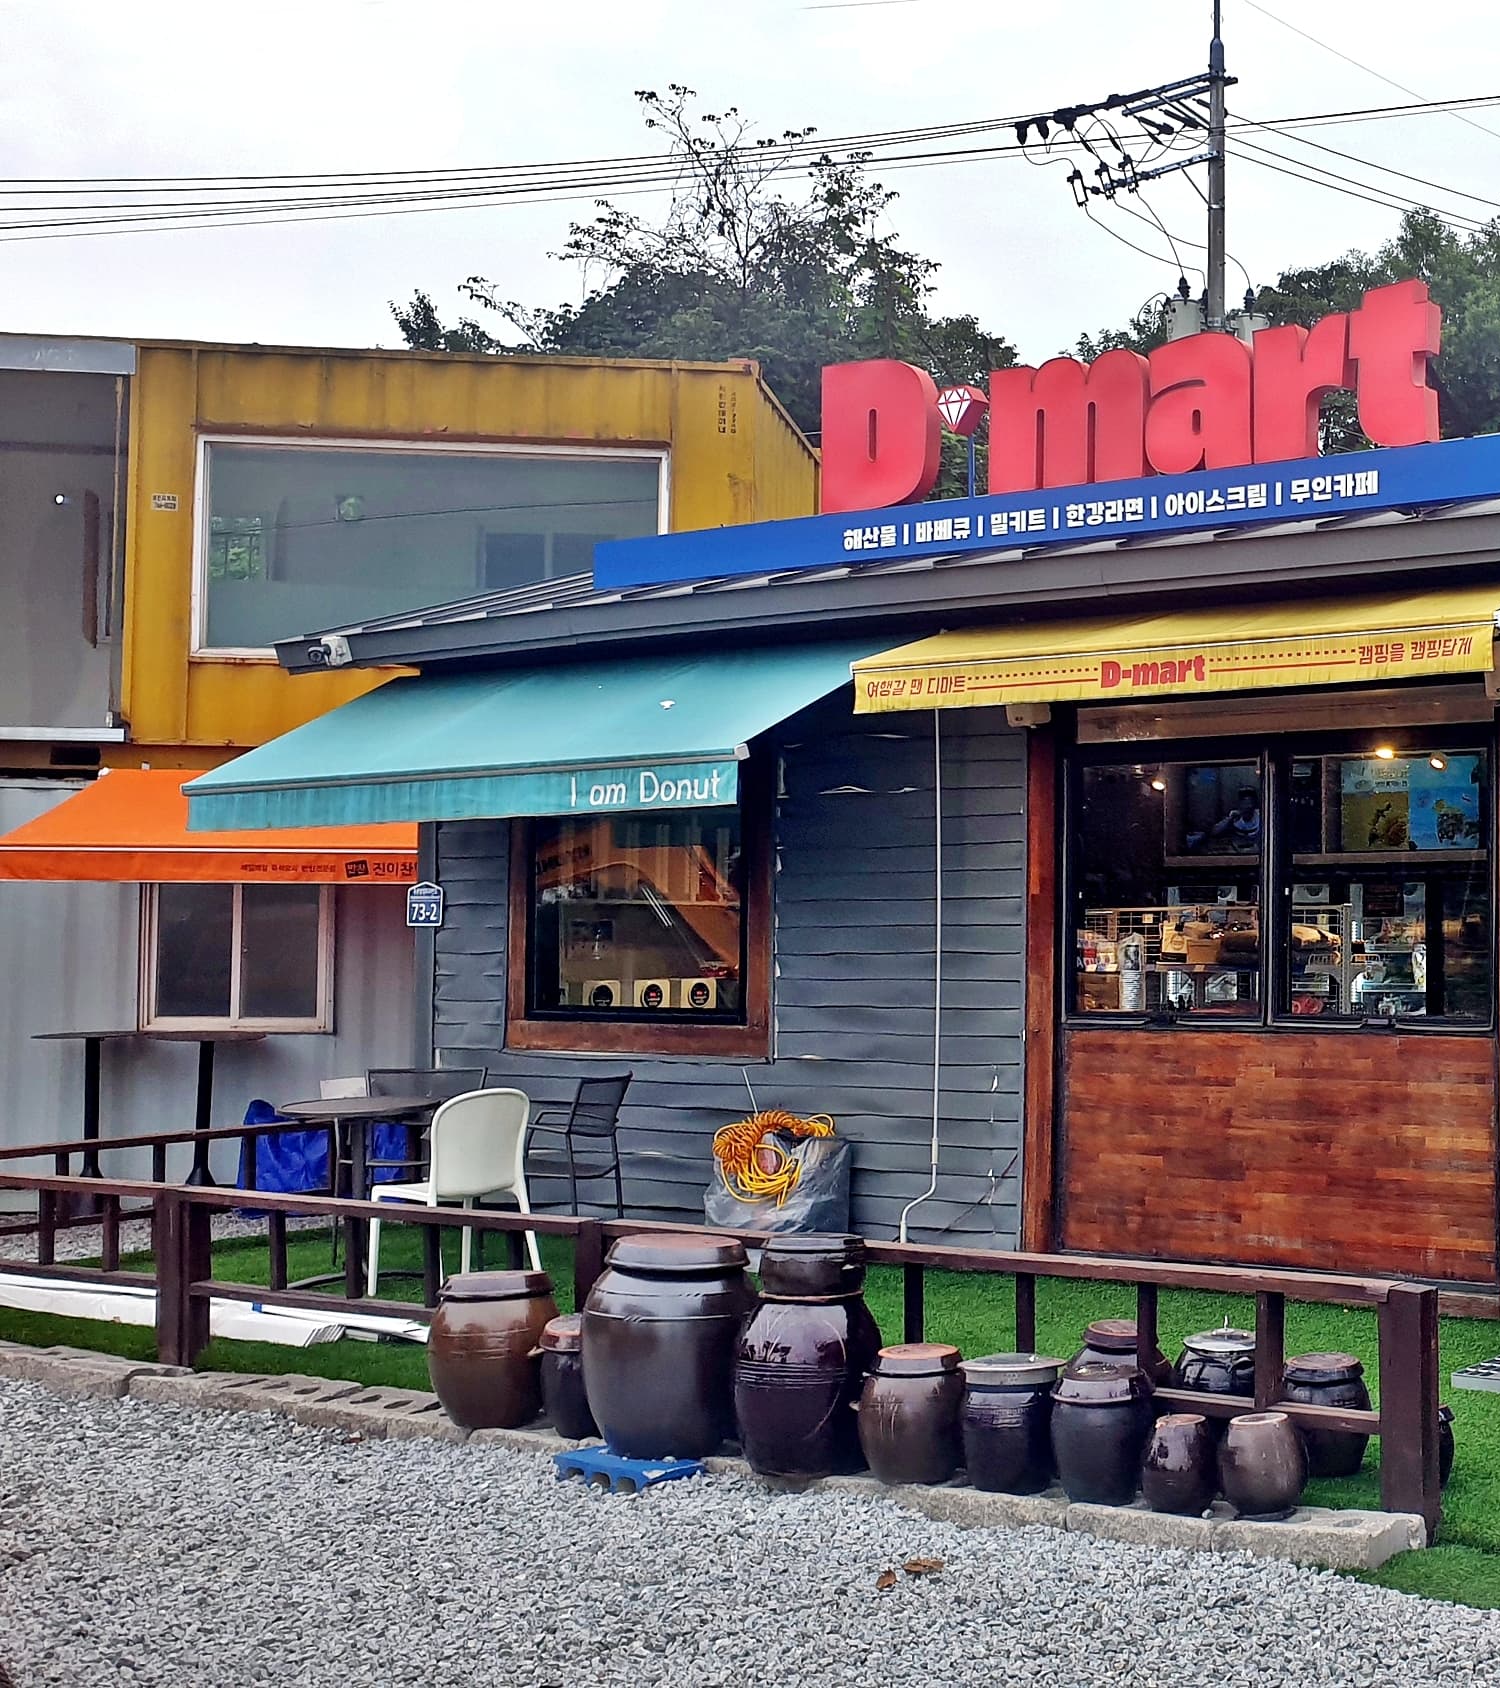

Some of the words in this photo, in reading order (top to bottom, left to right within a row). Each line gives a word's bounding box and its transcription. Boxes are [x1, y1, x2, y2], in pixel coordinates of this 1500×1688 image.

[821, 358, 941, 514] D
[989, 278, 1440, 495] mart
[843, 523, 897, 550] 해산물
[915, 517, 970, 544] 바베큐
[990, 508, 1046, 536] 밀키트
[1065, 497, 1144, 528] 한강라면
[1164, 483, 1267, 517] 아이스크림
[1289, 470, 1379, 503] 무인카페
[1358, 643, 1405, 665] 캠핑을
[1410, 637, 1473, 661] 캠핑답게
[867, 679, 907, 698] 여행갈
[927, 675, 967, 695] 디마트
[1100, 655, 1205, 688] D-mart
[571, 777, 577, 807] I
[589, 782, 627, 806] am
[639, 769, 721, 804] Donut
[372, 861, 418, 877] 진이찬
[411, 903, 438, 921] 73-2
